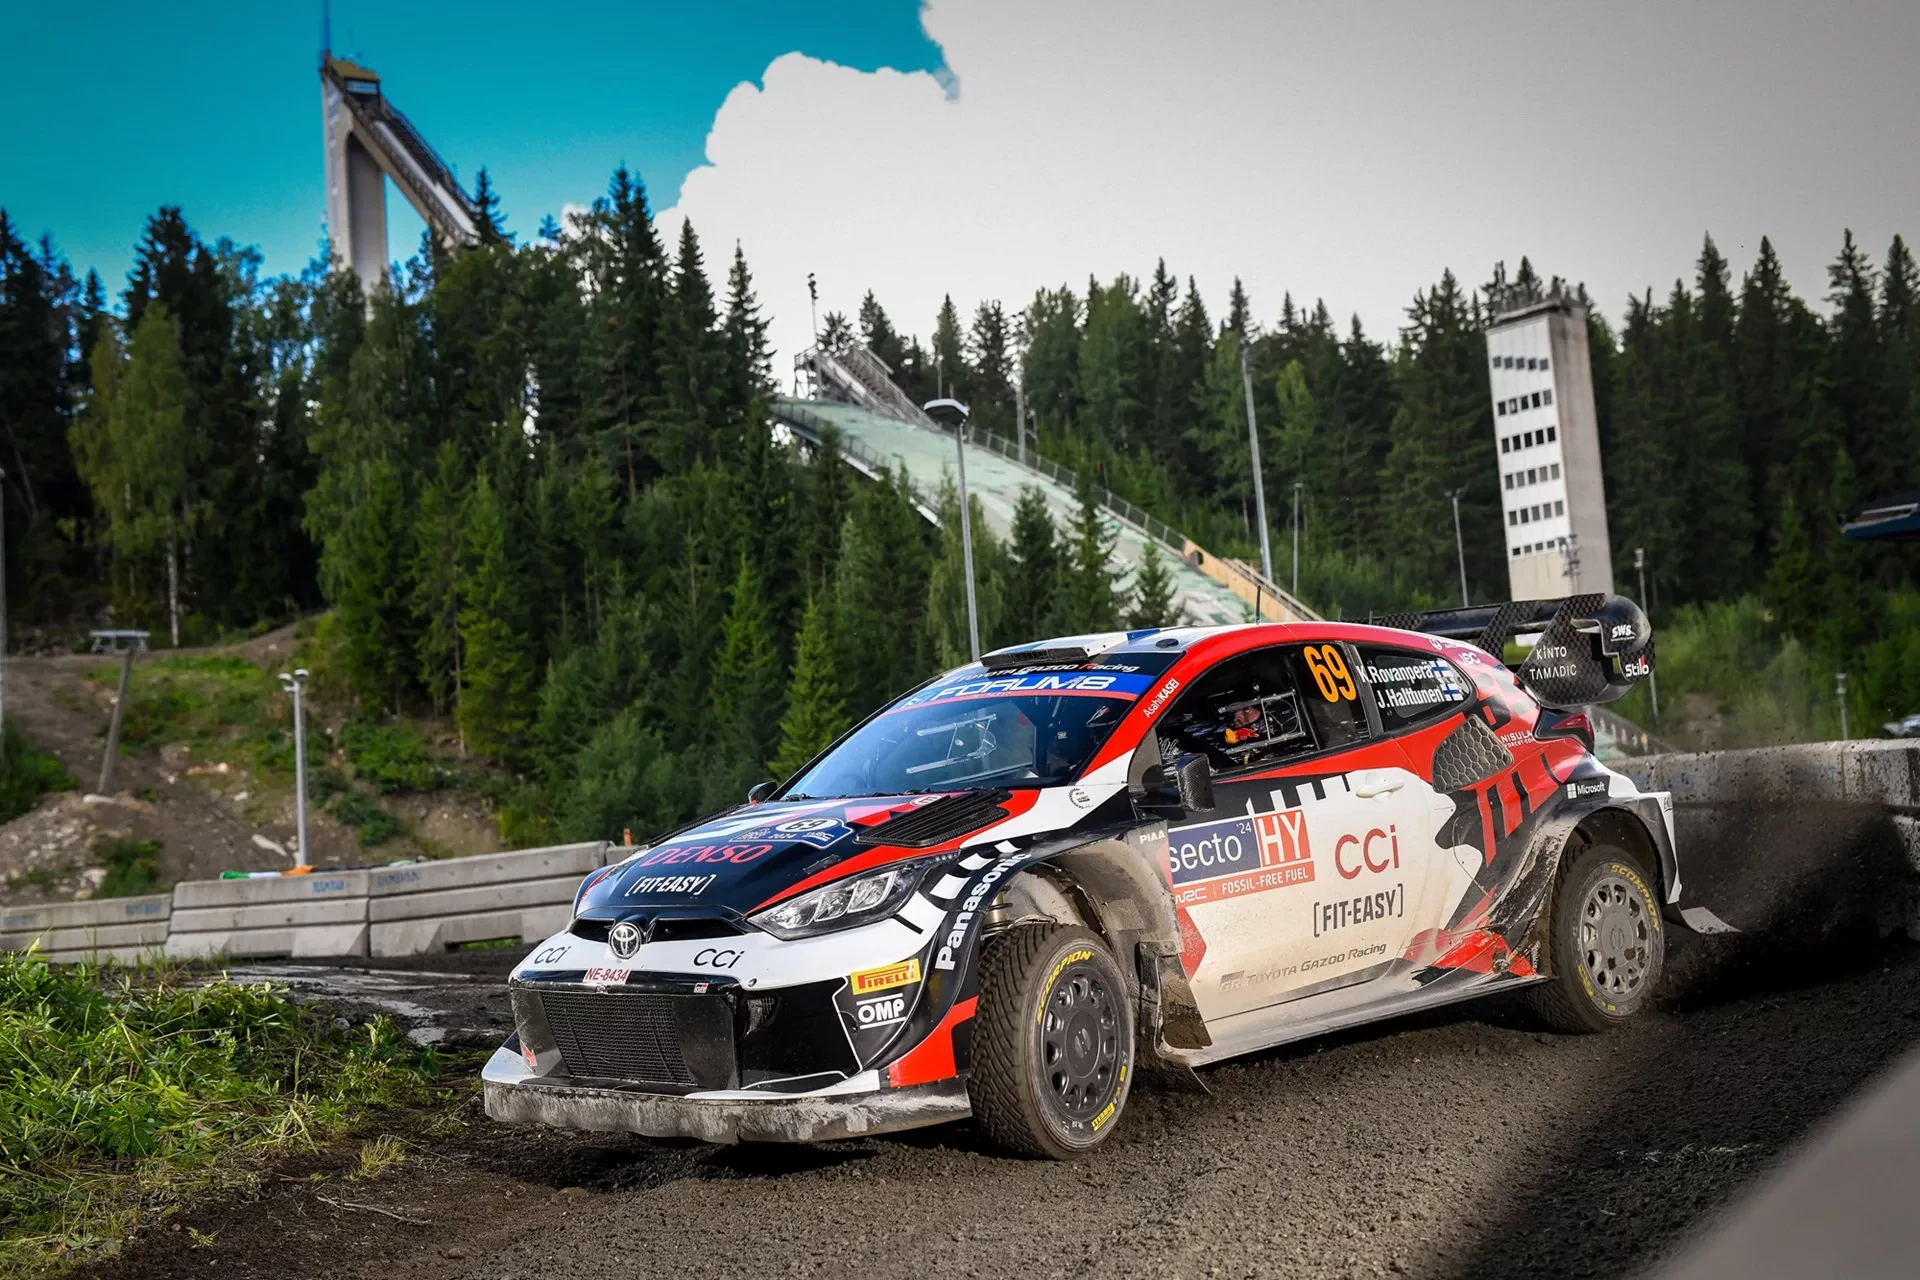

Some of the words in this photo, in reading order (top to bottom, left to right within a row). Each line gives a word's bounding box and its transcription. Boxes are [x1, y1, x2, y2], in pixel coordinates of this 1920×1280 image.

[1612, 624, 1632, 638] SWS
[1012, 664, 1079, 677] GAZOO
[1079, 662, 1141, 673] Racing
[1303, 644, 1357, 703] 69
[1529, 664, 1577, 681] TAMADIC
[1625, 657, 1650, 678] Stilo
[931, 674, 1117, 701] FORUM8
[1500, 729, 1534, 743] NISULA
[1577, 782, 1606, 795] Microsoft
[784, 819, 829, 831] 69
[1139, 830, 1165, 844] PIAA
[1257, 812, 1302, 866] HY
[640, 844, 773, 867] DENSO
[1221, 873, 1284, 896] FOSSIL-FREE
[1285, 867, 1309, 882] FUEL
[935, 852, 1032, 970] Panasonic
[1299, 952, 1346, 974] GAZOO
[1347, 942, 1388, 961] Racing
[584, 967, 630, 982] NE-8434
[858, 964, 915, 990] PIRELLI
[1035, 950, 1092, 1025] SCORPION
[858, 999, 905, 1024] OMP
